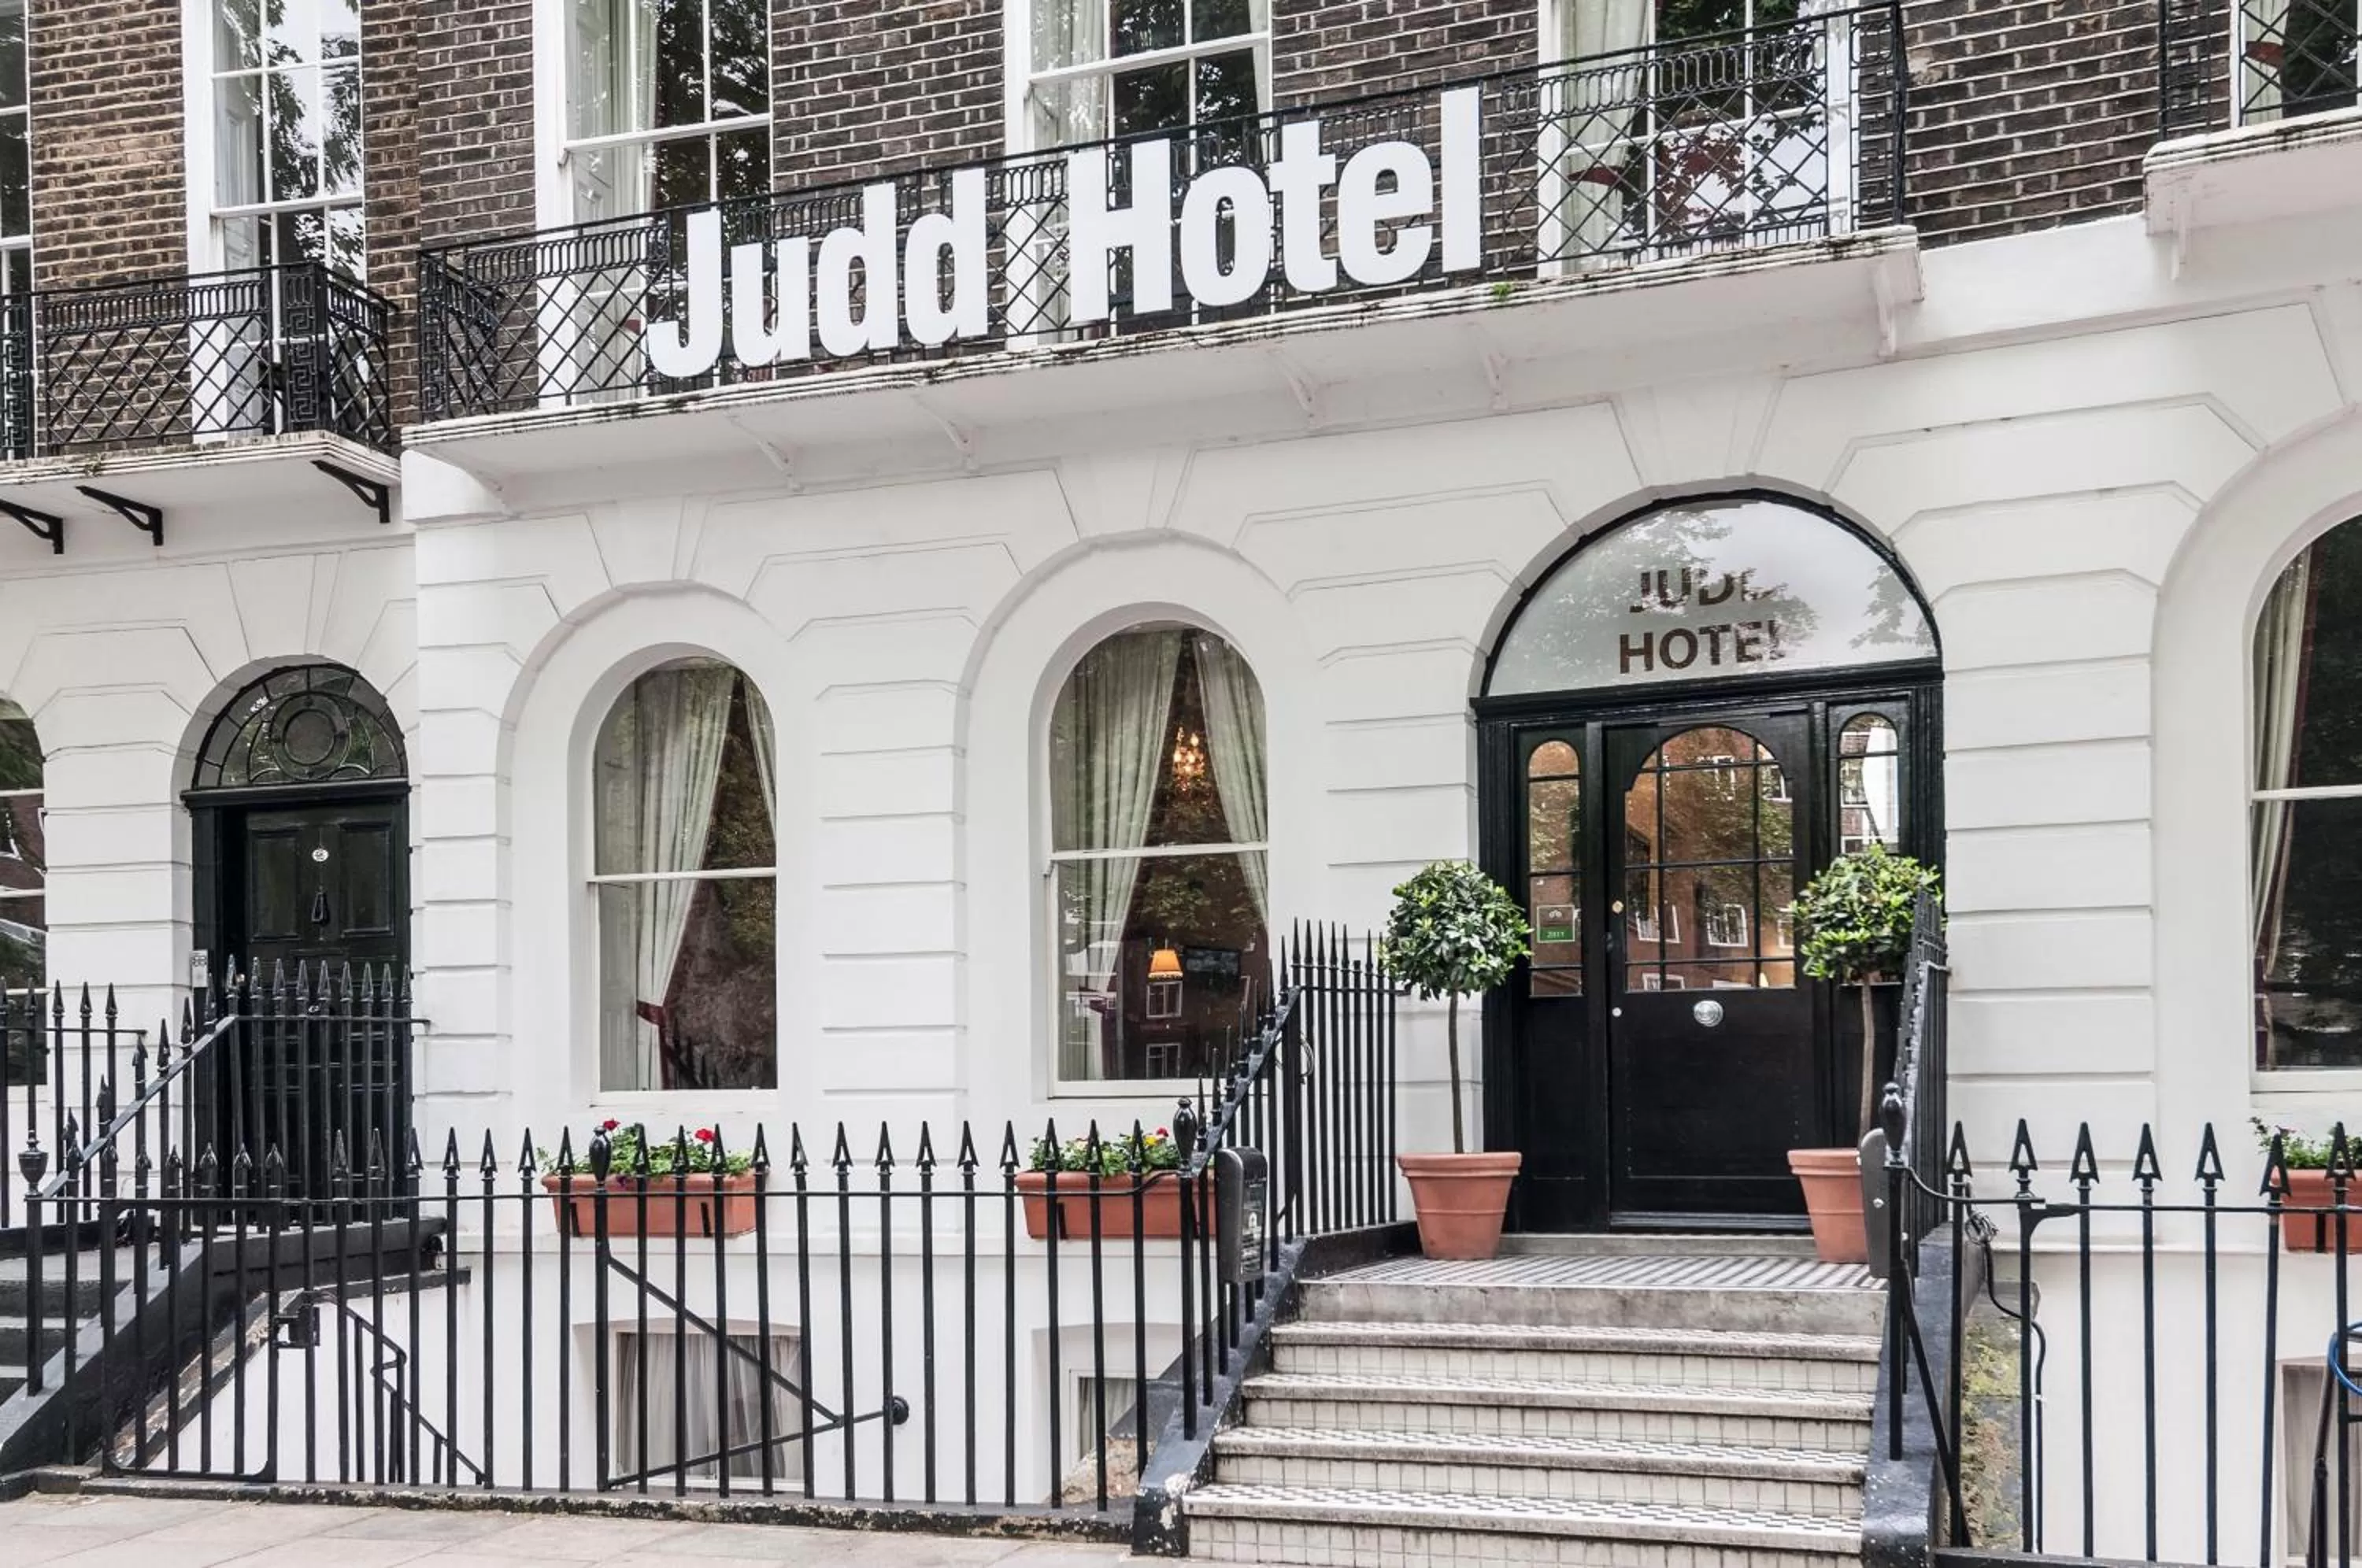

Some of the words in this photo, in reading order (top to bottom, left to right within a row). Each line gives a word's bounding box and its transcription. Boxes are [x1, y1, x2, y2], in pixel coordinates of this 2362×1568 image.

[647, 168, 988, 377] Judd
[1068, 86, 1481, 322] Hotel
[1620, 619, 1785, 674] HOTEL
